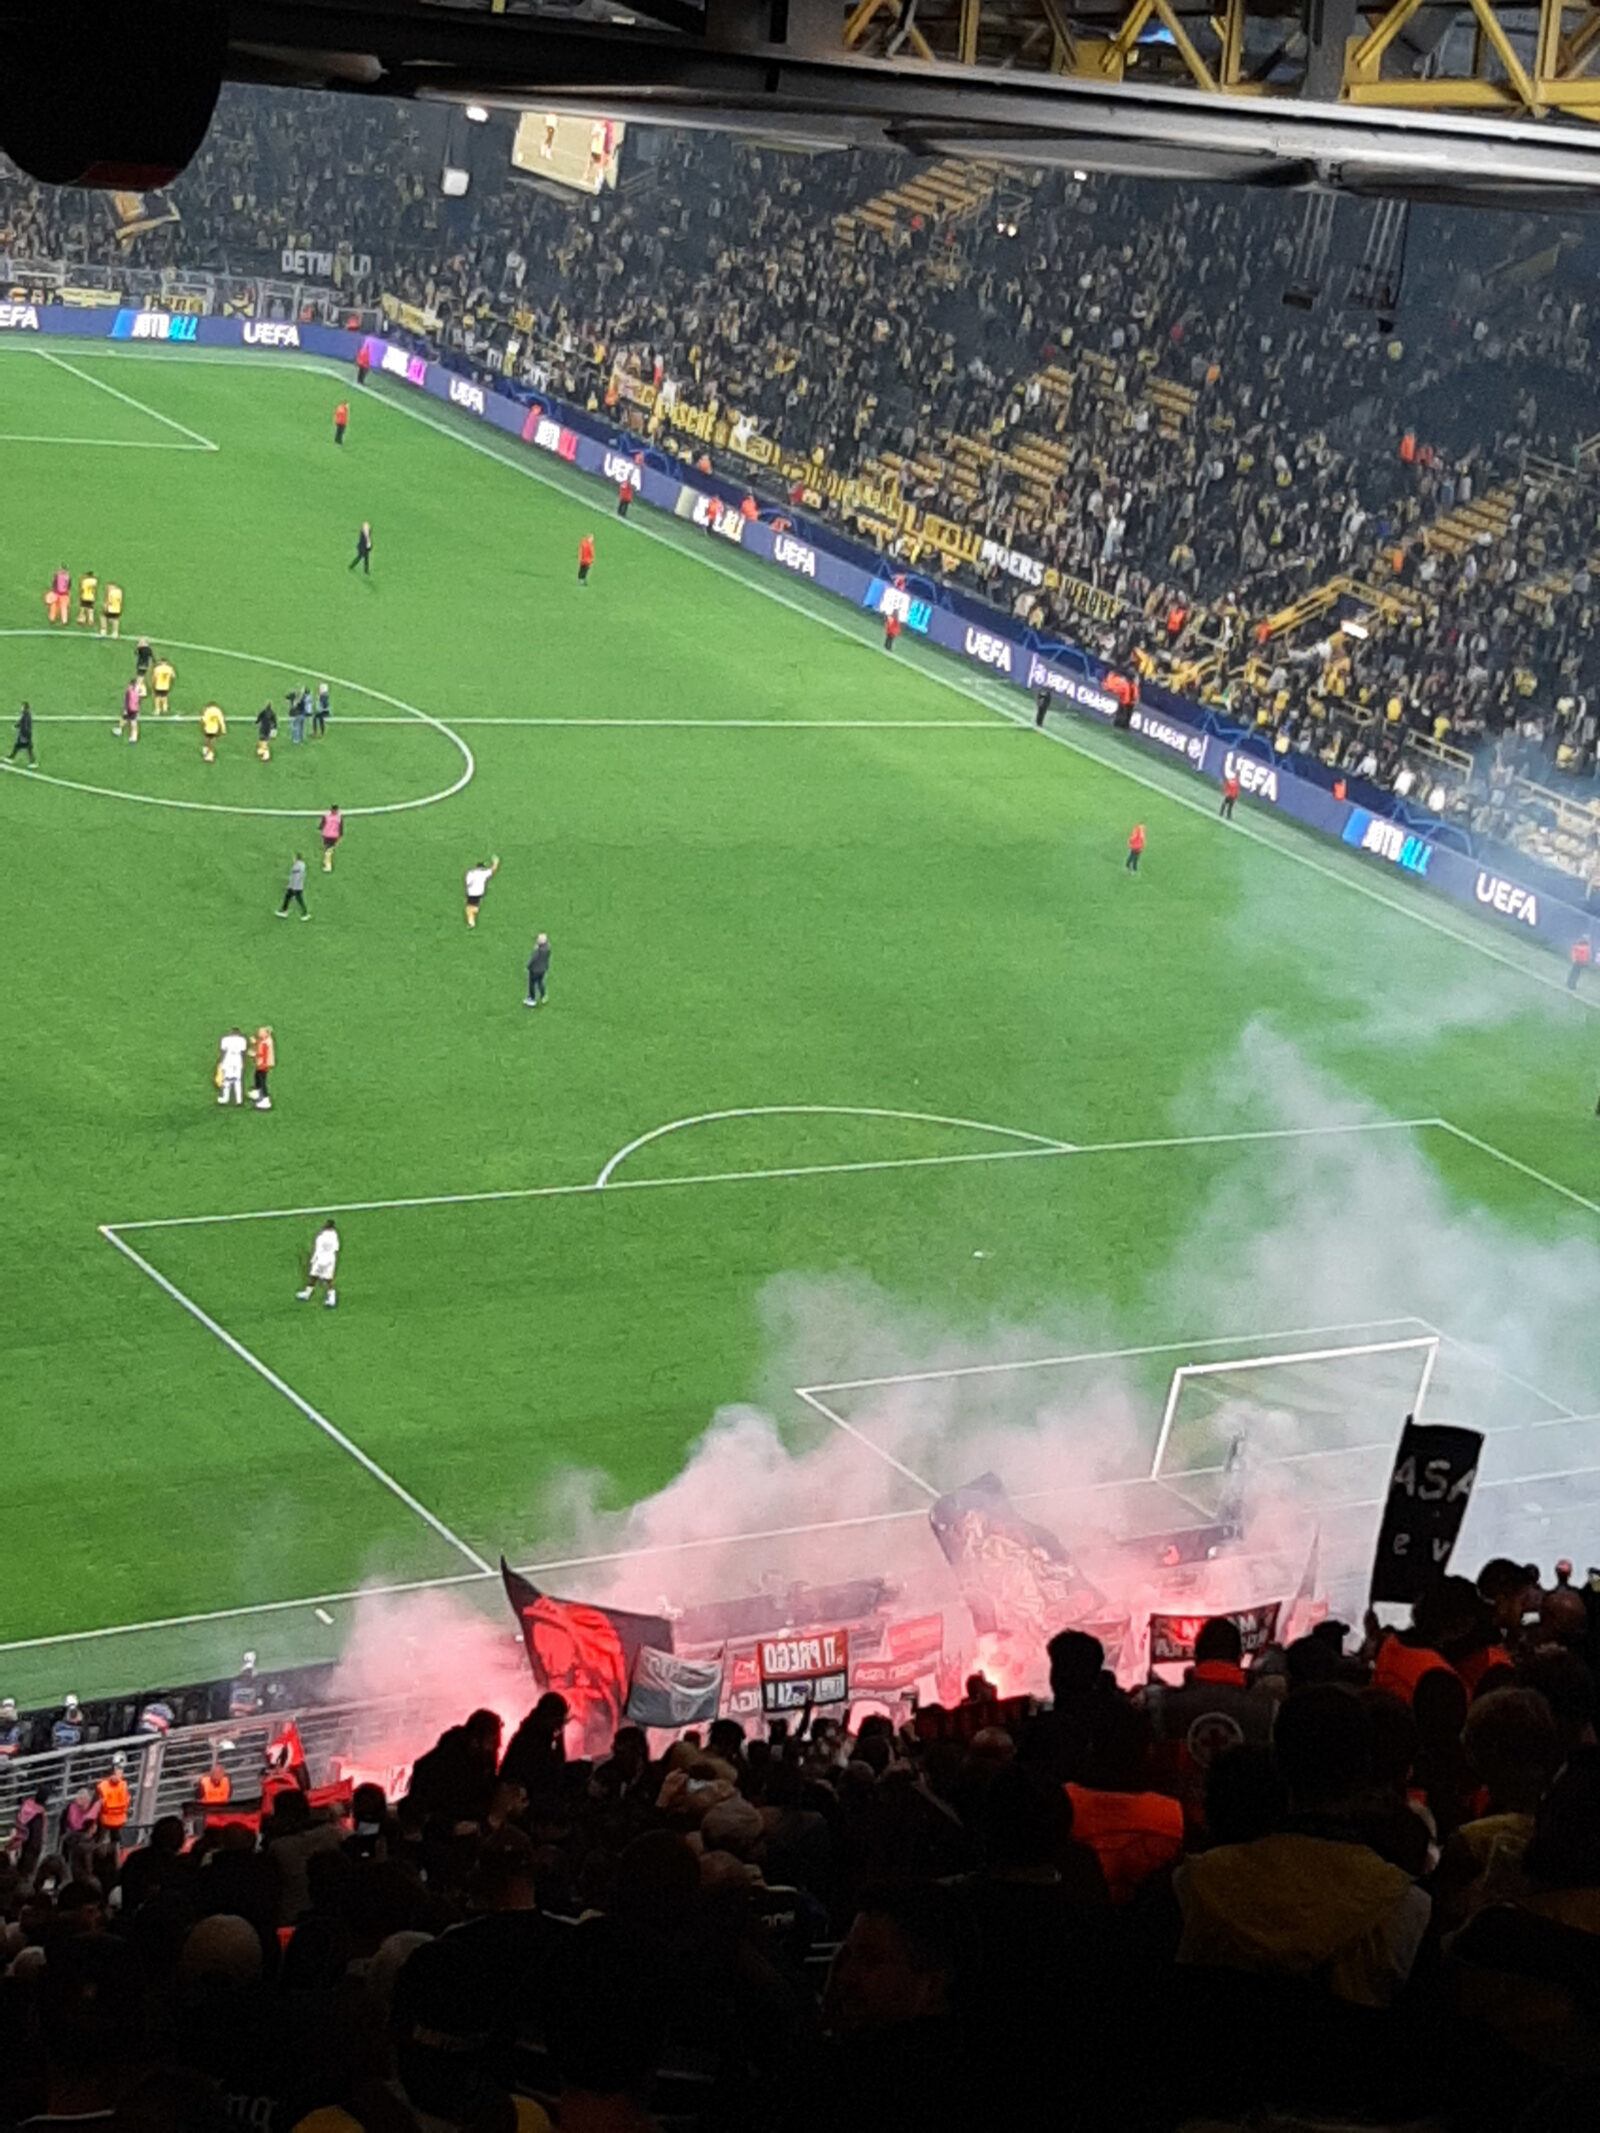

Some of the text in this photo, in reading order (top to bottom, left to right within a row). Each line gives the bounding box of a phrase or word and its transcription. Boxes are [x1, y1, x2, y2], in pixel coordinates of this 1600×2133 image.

[281, 250, 372, 277] DETMLD
[0, 304, 39, 330] EFA
[243, 320, 300, 347] UEFA
[450, 378, 485, 416] UEFA
[603, 452, 642, 491] UEFA
[775, 535, 815, 577] UEFA
[980, 538, 1045, 587] MOERS
[965, 626, 1011, 672] UEFA
[1224, 751, 1277, 802] UEFA
[1476, 872, 1537, 925] UEFA
